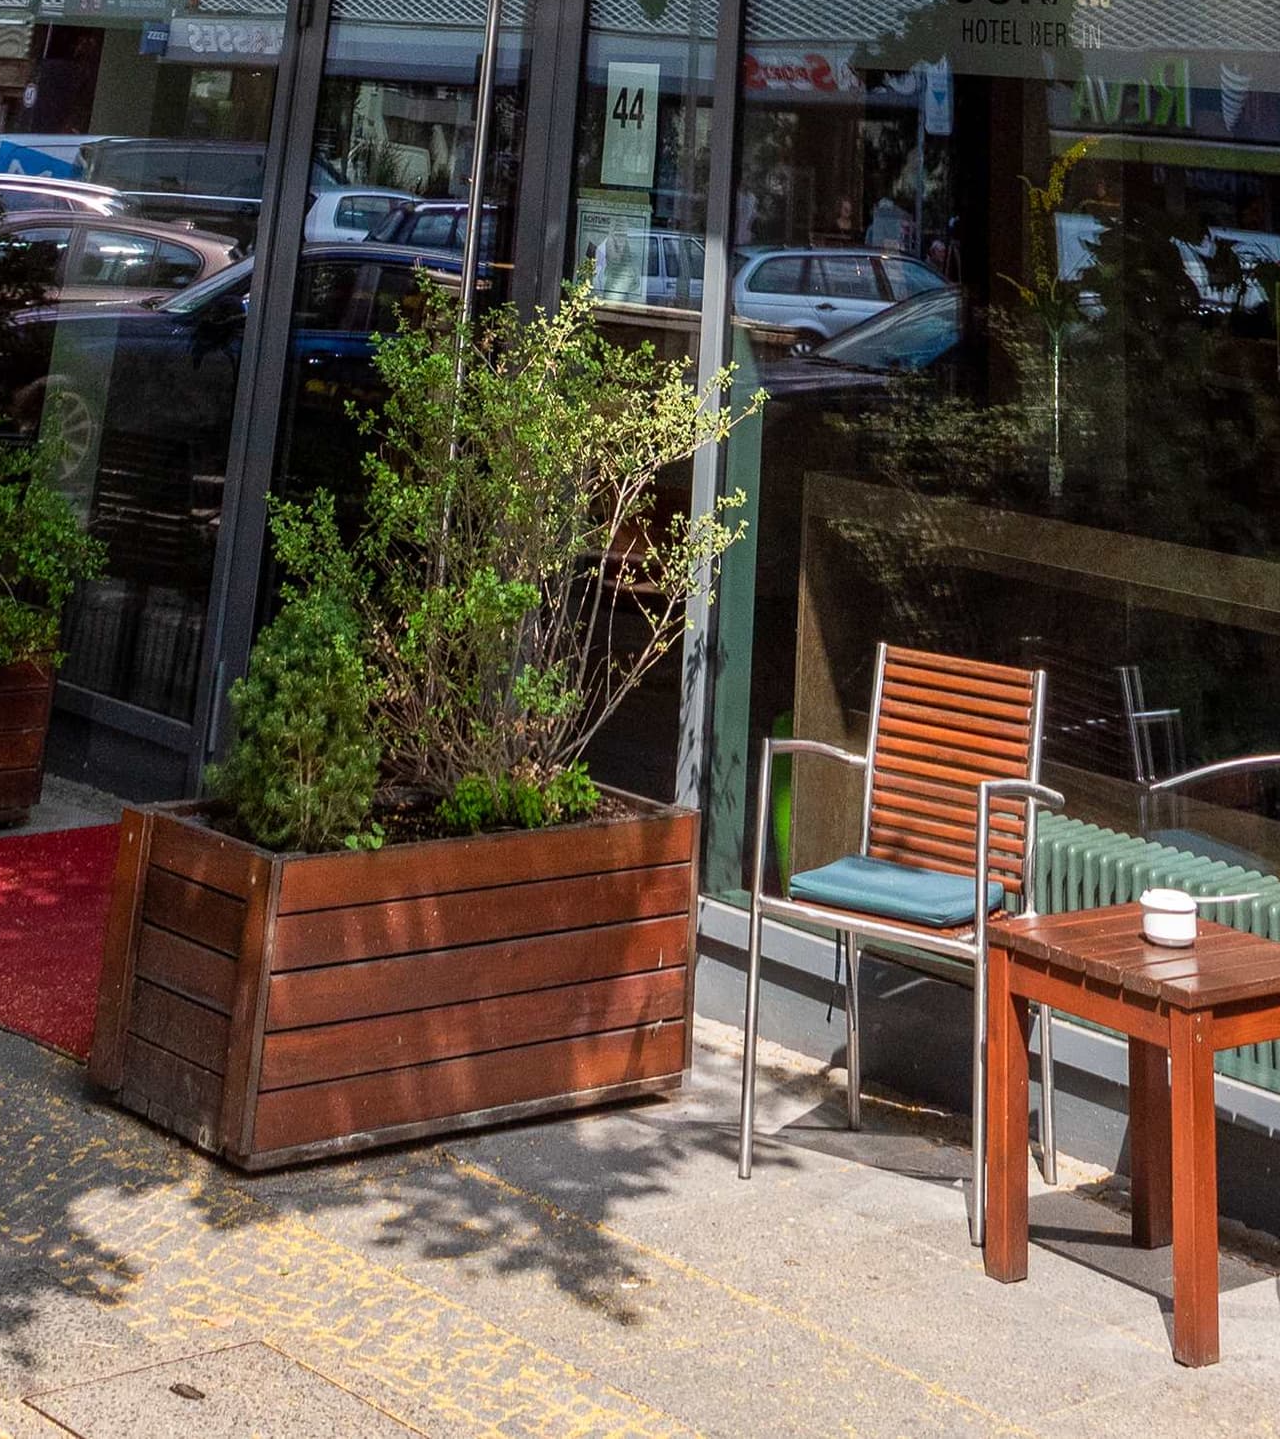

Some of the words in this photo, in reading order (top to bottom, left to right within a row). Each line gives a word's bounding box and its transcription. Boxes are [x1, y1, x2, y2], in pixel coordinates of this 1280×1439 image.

[961, 17, 1022, 45] HOTEL
[1030, 19, 1101, 50] BERIN
[612, 86, 645, 130] 44
